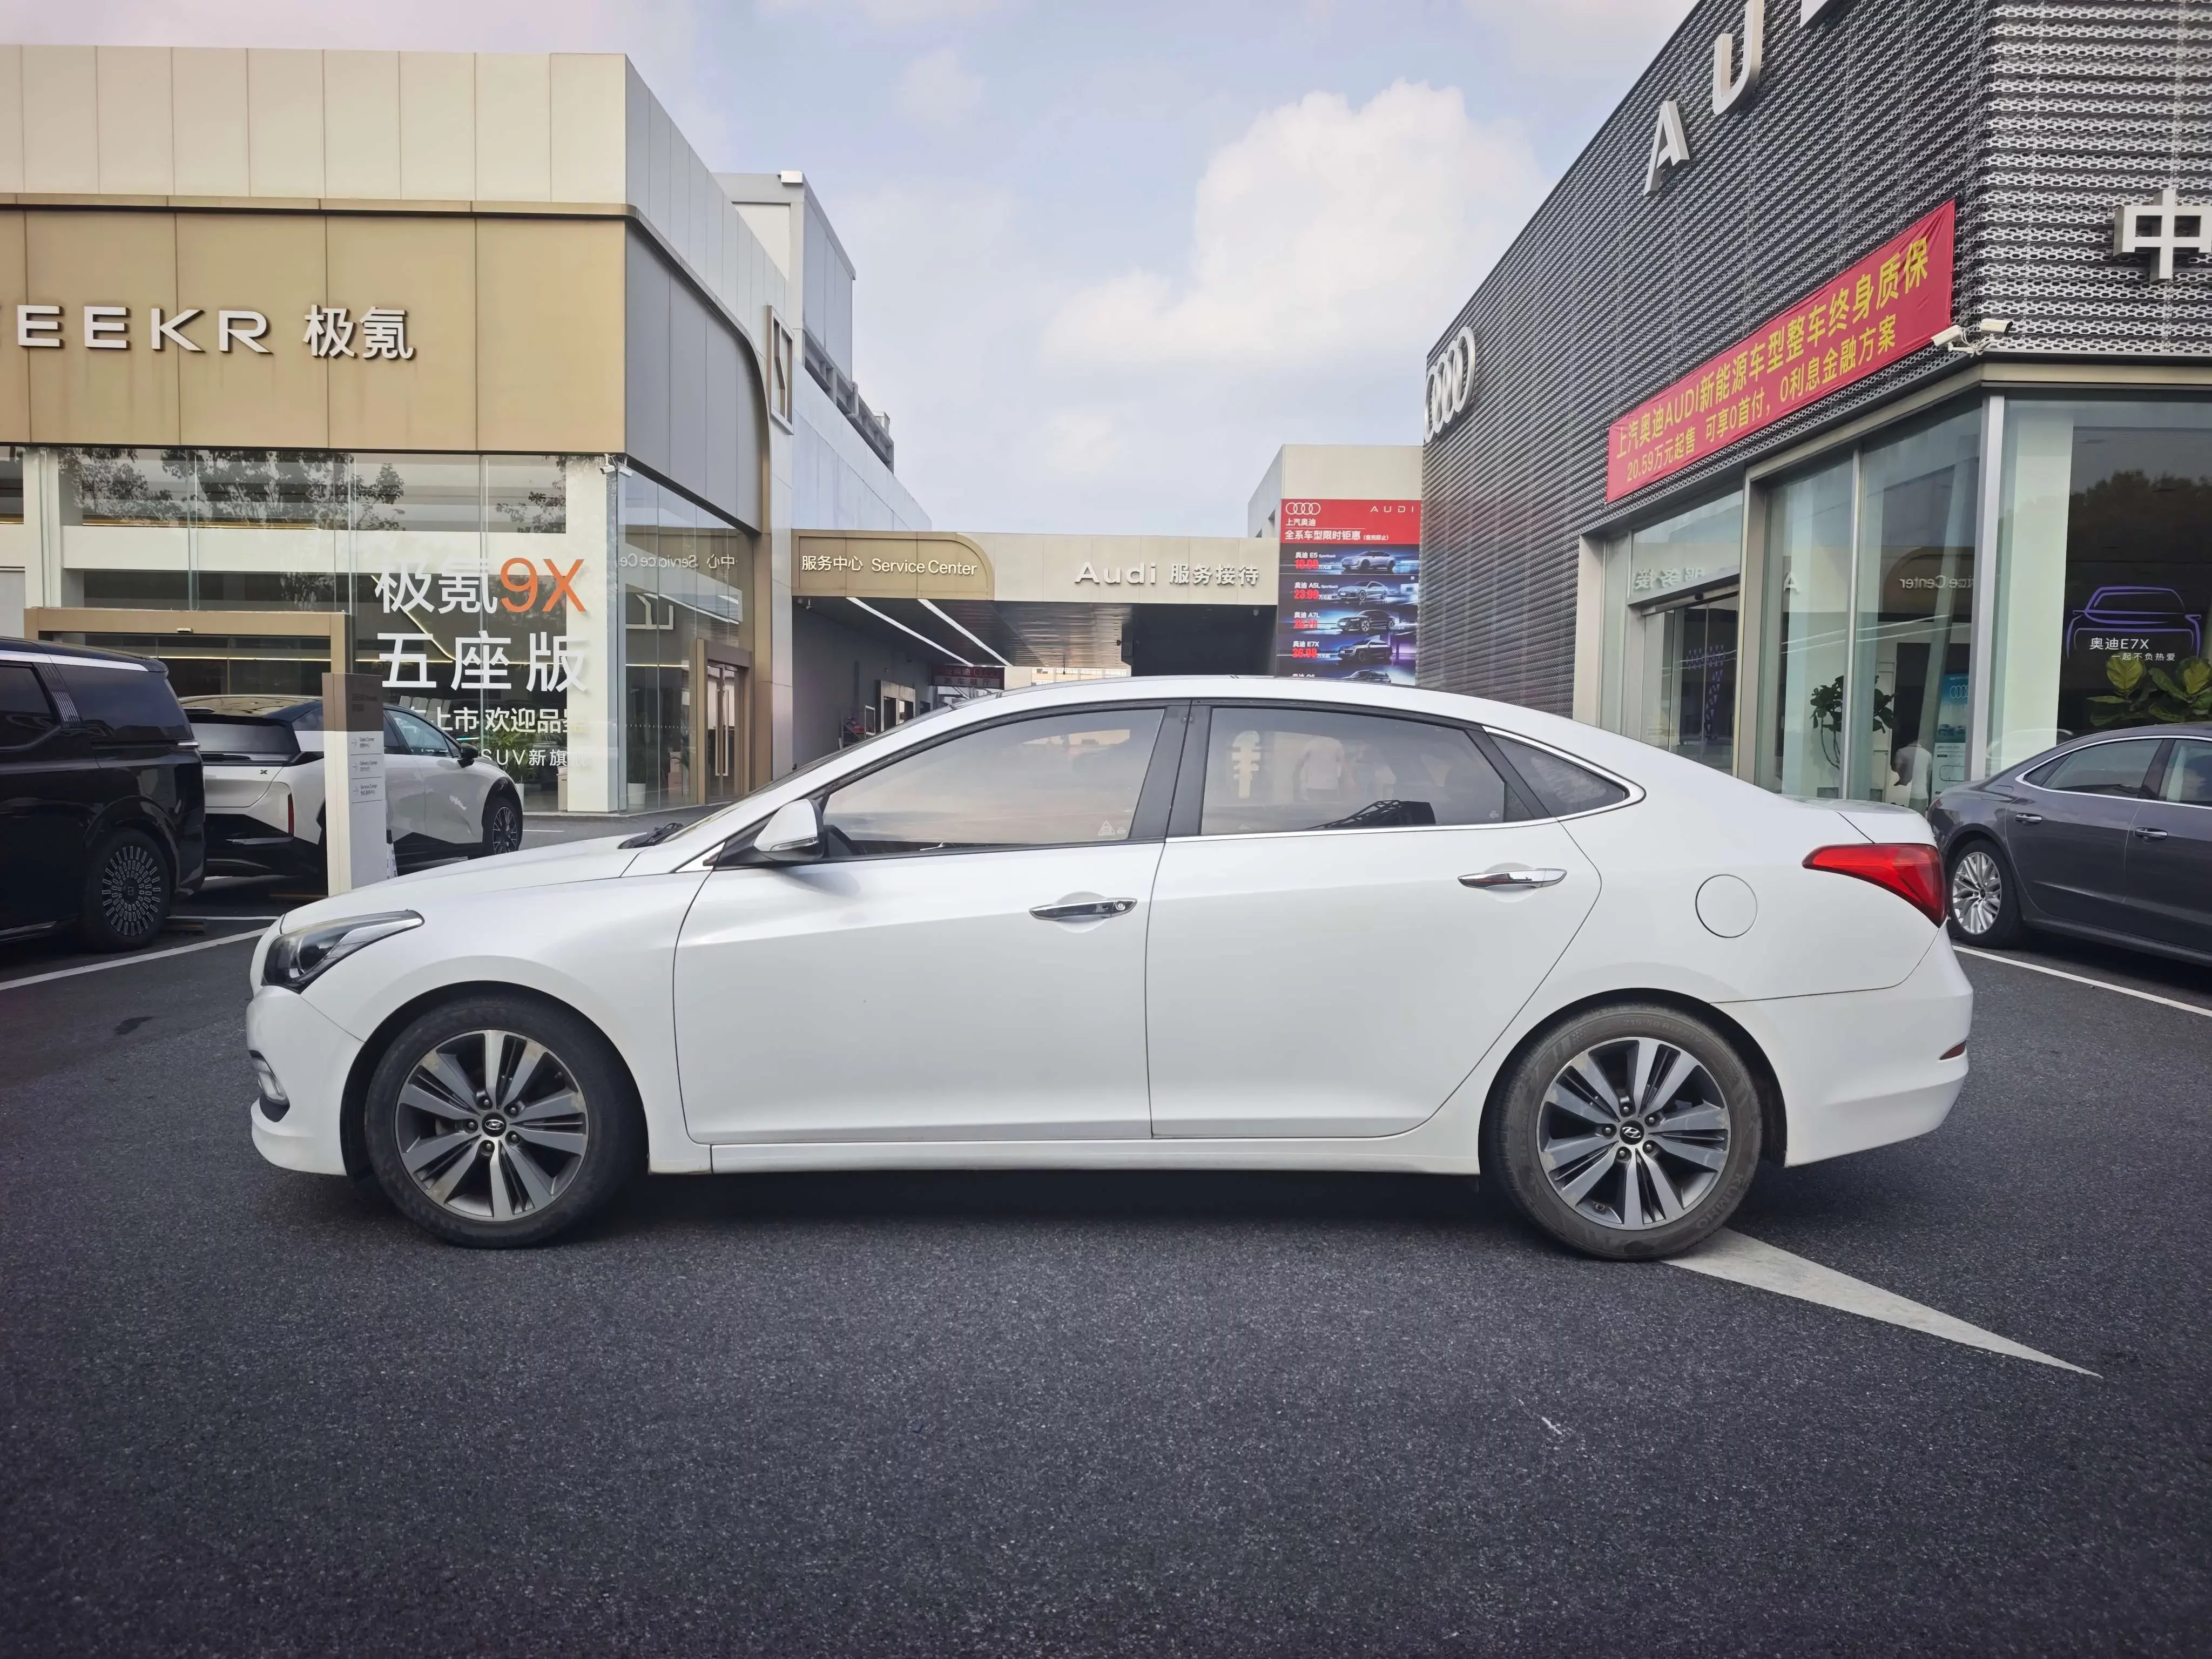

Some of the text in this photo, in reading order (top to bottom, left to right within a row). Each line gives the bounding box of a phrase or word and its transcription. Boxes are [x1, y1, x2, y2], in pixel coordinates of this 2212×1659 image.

[2113, 189, 2212, 282] 中
[304, 303, 415, 360] 极氪
[1616, 237, 1930, 460] 上汽奥迪AUDI新能源车型整车终身质保
[1627, 426, 1696, 483] 20.59万元起售
[1285, 518, 1316, 527] 上汽奥迪
[1285, 529, 1361, 540] 全系车型限时钜惠
[801, 555, 977, 576] 服务中心 Service Center
[1074, 561, 1260, 586] Audi 服务接待
[374, 557, 587, 615] 极氪9X
[2089, 637, 2150, 650] 奥迪E7X
[2110, 652, 2176, 662] 一起不负热爱
[377, 631, 589, 692] 五座版
[485, 706, 568, 734] 欢迎品
[480, 748, 578, 769] SUV新旗
[1697, 1172, 1744, 1230] KUMHO
